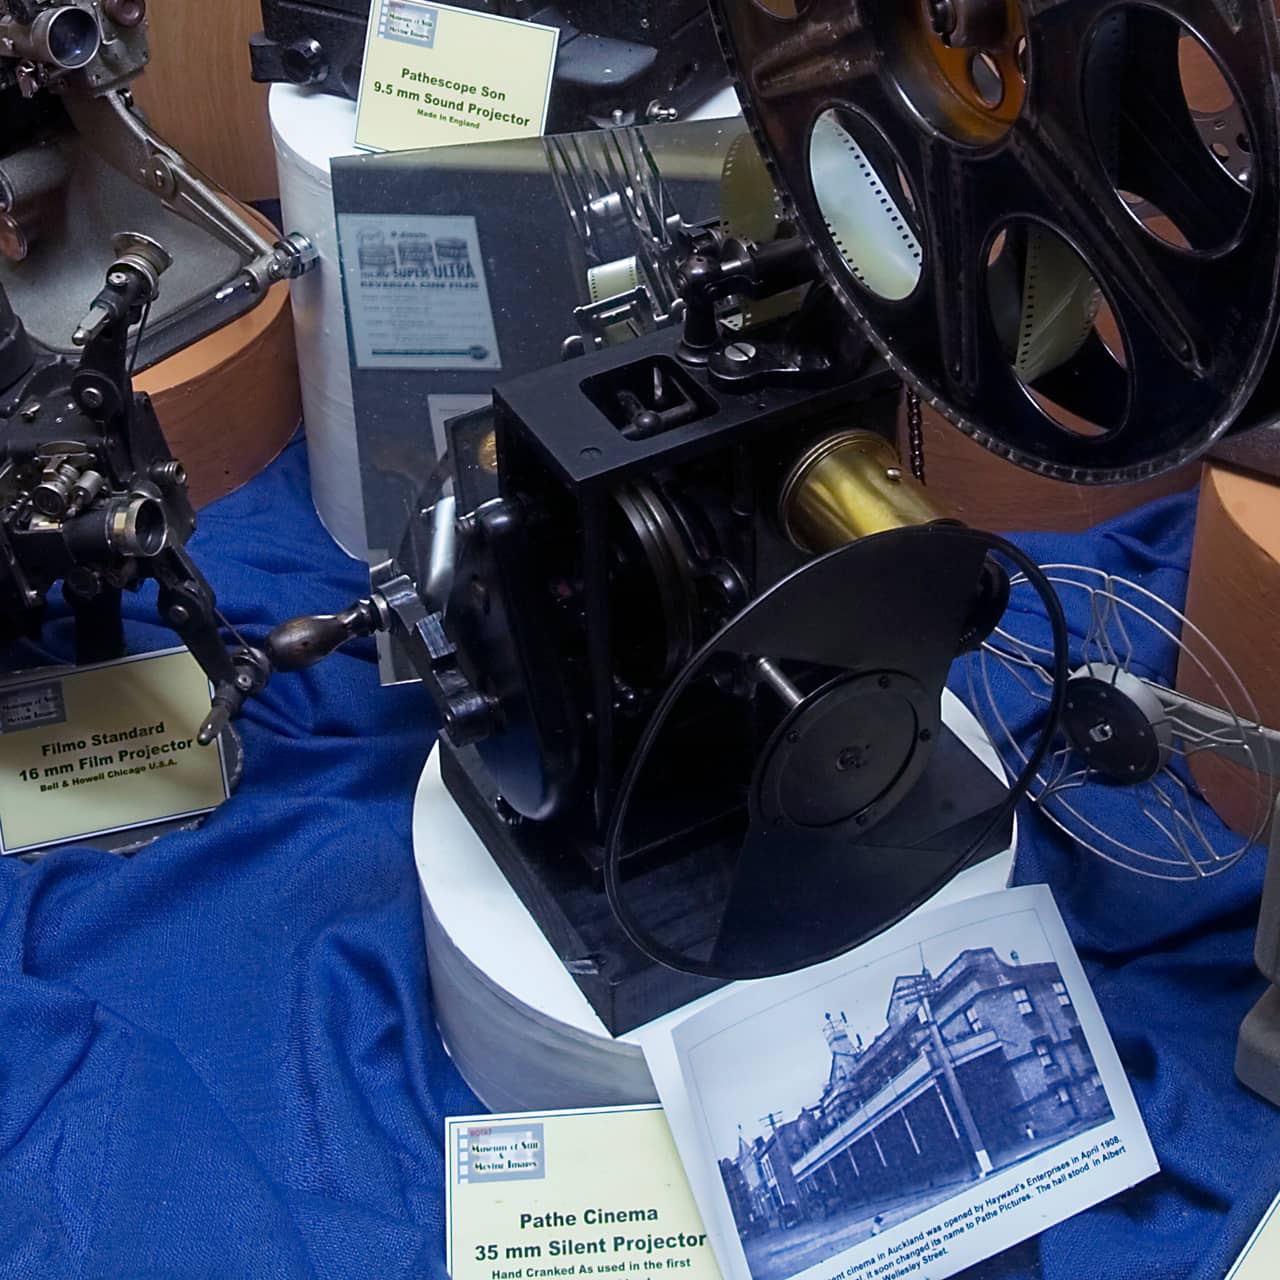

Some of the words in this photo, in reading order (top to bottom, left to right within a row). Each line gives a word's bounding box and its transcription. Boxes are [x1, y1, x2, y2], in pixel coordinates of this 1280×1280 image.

[402, 68, 476, 94] Pathescope
[482, 86, 506, 101] Son
[374, 81, 392, 95] 9.5
[397, 88, 420, 102] mm
[424, 92, 464, 111] Sound
[468, 104, 530, 126] Projector
[417, 108, 437, 120] Made
[449, 115, 480, 129] England
[42, 739, 85, 756] Filmo
[92, 722, 165, 746] Standard
[19, 768, 38, 781] 16
[45, 763, 73, 778] mm
[80, 755, 113, 770] Film
[119, 737, 192, 761] Projector
[520, 1211, 576, 1229] Pathe
[584, 1208, 658, 1225] Cinema
[847, 1257, 876, 1276] cinema
[877, 1253, 886, 1261] in
[887, 1233, 924, 1256] Auckland
[926, 1225, 941, 1237] was
[943, 1209, 972, 1227] opened
[974, 1204, 984, 1212] by
[985, 1184, 1025, 1207] Hayward's
[1026, 1161, 1070, 1186] Enterprises
[1072, 1155, 1079, 1164] in
[1081, 1146, 1099, 1160] April
[1100, 1135, 1121, 1148] 1908.
[476, 1245, 498, 1261] 35
[506, 1242, 541, 1259] mm
[549, 1236, 606, 1256] Silent
[614, 1232, 706, 1253] Projector
[492, 1269, 522, 1280] Hand
[526, 1264, 574, 1279] Cranked
[580, 1264, 593, 1274] As
[598, 1260, 624, 1273] used
[630, 1260, 640, 1270] in
[644, 1259, 662, 1270] the
[666, 1258, 691, 1268] first
